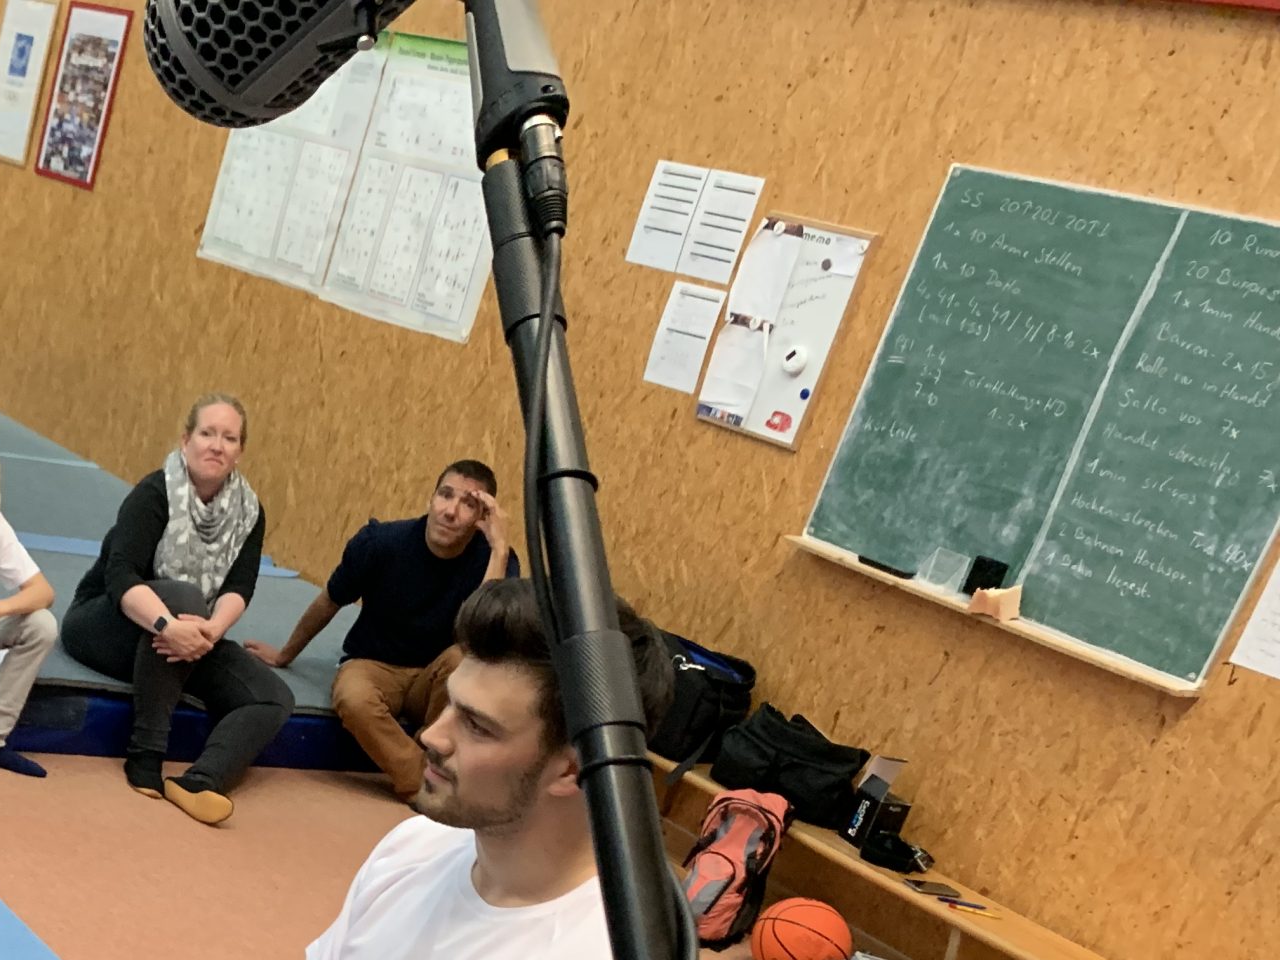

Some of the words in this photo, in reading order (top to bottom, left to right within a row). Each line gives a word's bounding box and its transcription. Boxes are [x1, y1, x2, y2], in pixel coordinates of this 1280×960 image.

[969, 228, 987, 244] 10
[1209, 229, 1232, 246] 10
[959, 262, 976, 277] 10
[1186, 260, 1209, 279] 20
[1119, 388, 1167, 414] Salto
